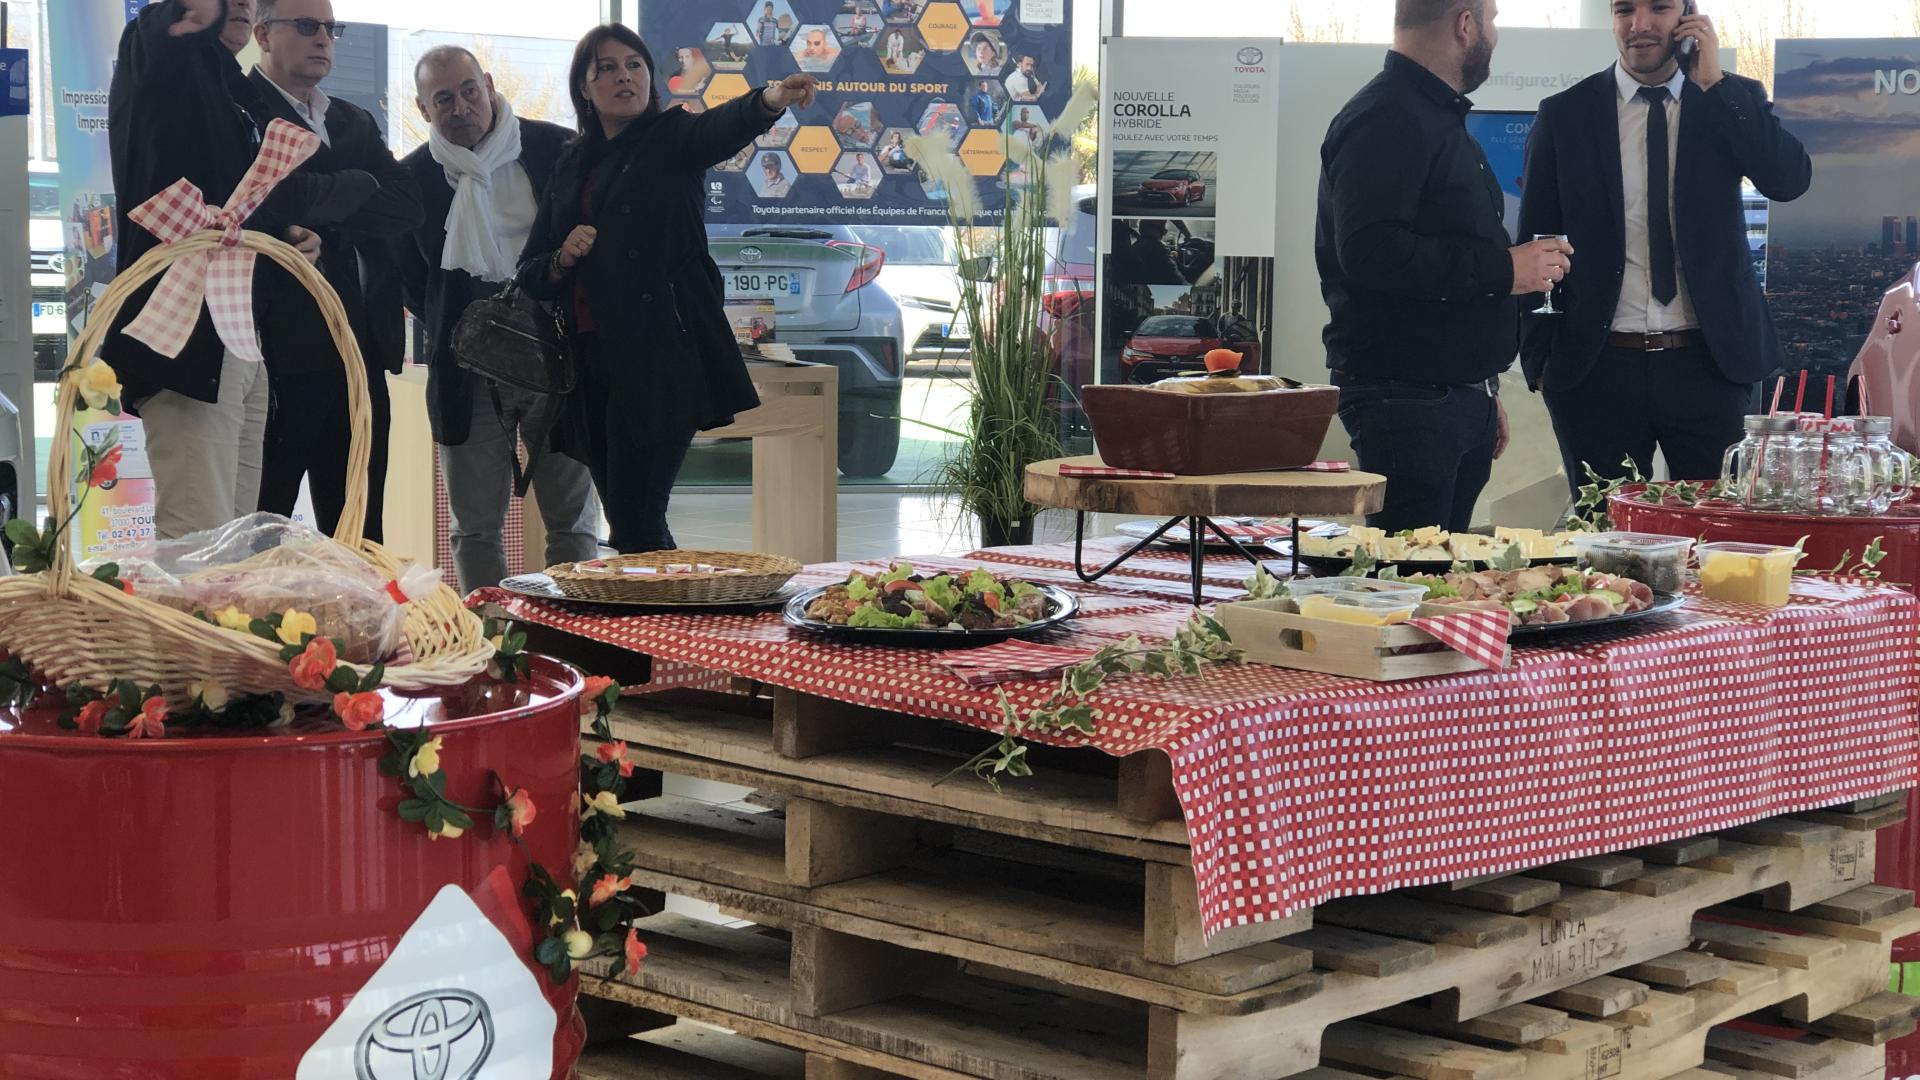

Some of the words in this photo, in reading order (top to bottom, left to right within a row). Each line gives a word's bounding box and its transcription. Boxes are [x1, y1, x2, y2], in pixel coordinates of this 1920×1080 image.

[836, 81, 885, 93] AUTOUR
[889, 82, 907, 93] DU
[910, 83, 948, 94] SPORT
[1486, 72, 1557, 90] onfigurez
[1113, 91, 1175, 102] NOUVELLE
[1113, 103, 1191, 117] COROLLA
[1113, 118, 1162, 129] HYBRIDE
[1193, 134, 1219, 142] TEMPS
[752, 204, 780, 215] Toyota
[781, 205, 825, 217] partenaire
[826, 205, 855, 215] officiel
[856, 205, 871, 215] des
[872, 203, 905, 217] Équipes
[906, 206, 917, 216] de
[918, 207, 946, 216] France
[993, 208, 1002, 217] et
[721, 274, 788, 291] -190-PG
[112, 530, 123, 539] 02
[127, 528, 137, 537] 47
